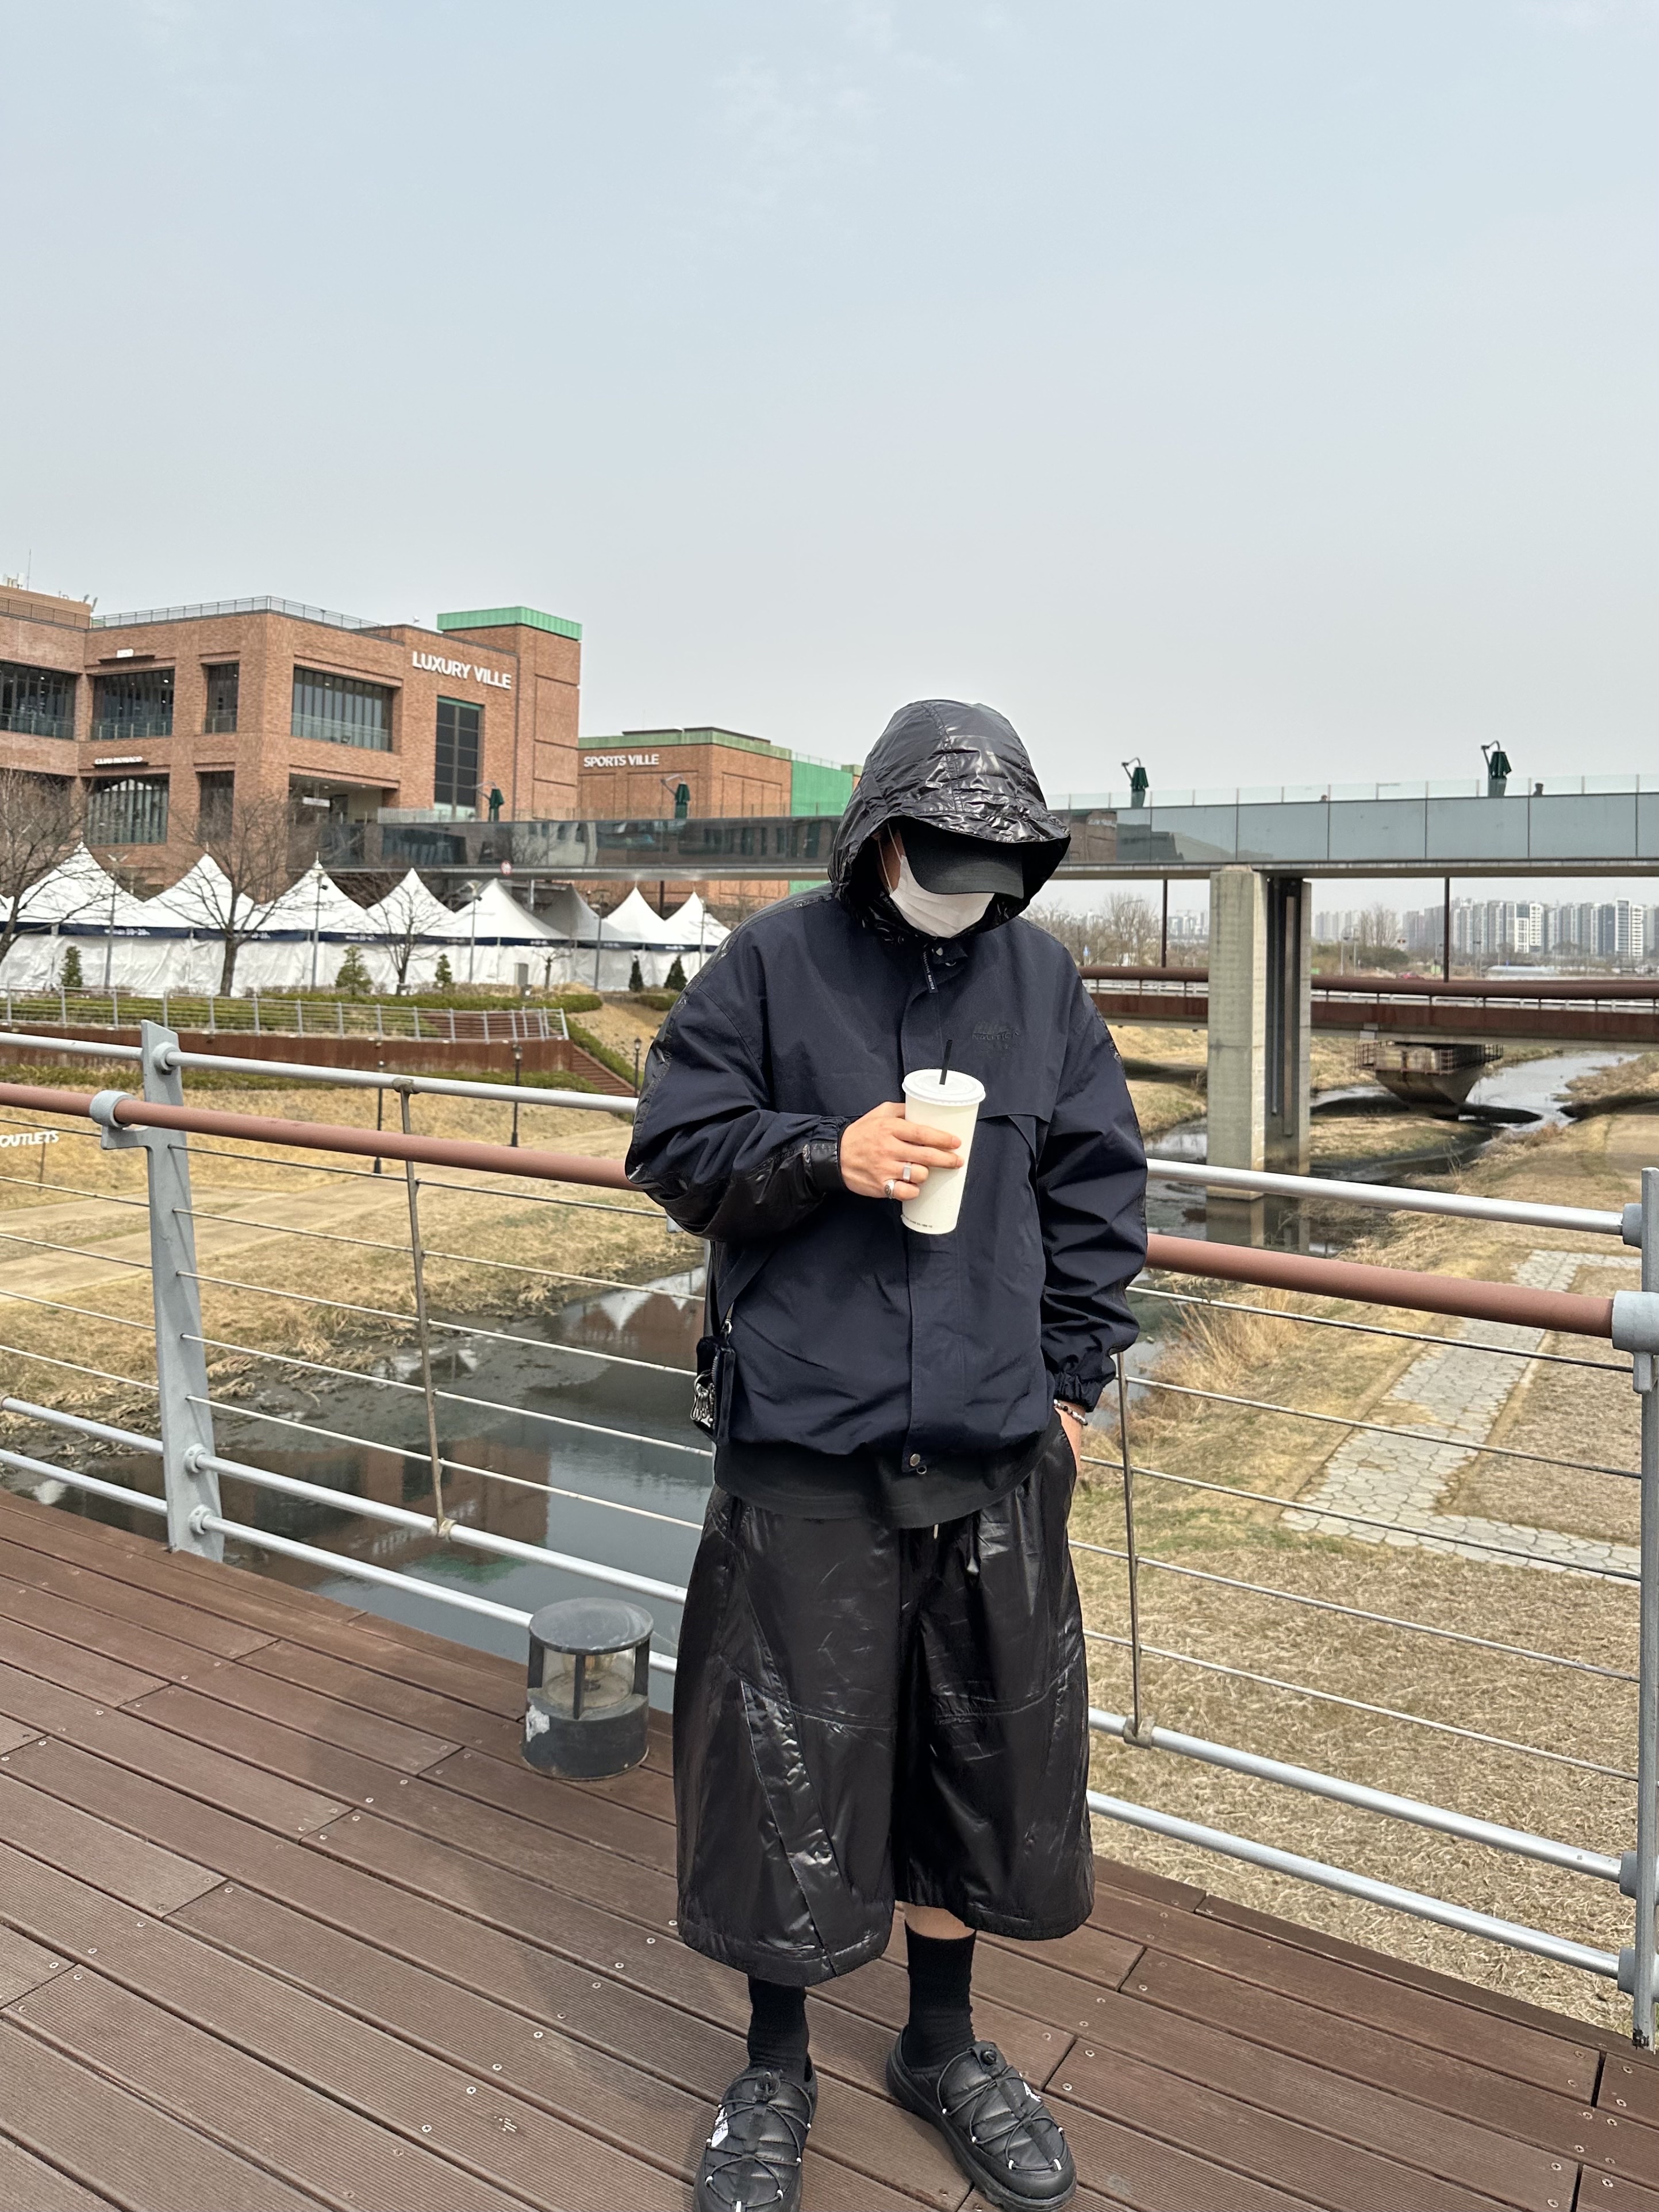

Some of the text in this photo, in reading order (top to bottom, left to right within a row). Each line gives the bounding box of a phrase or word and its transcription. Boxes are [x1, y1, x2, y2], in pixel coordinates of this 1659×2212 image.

[413, 651, 512, 689] LUXURY VILLE
[583, 753, 659, 767] SPORTS VILLE
[972, 1031, 1019, 1041] NAUTICA
[0, 1130, 59, 1148] OUTLETS
